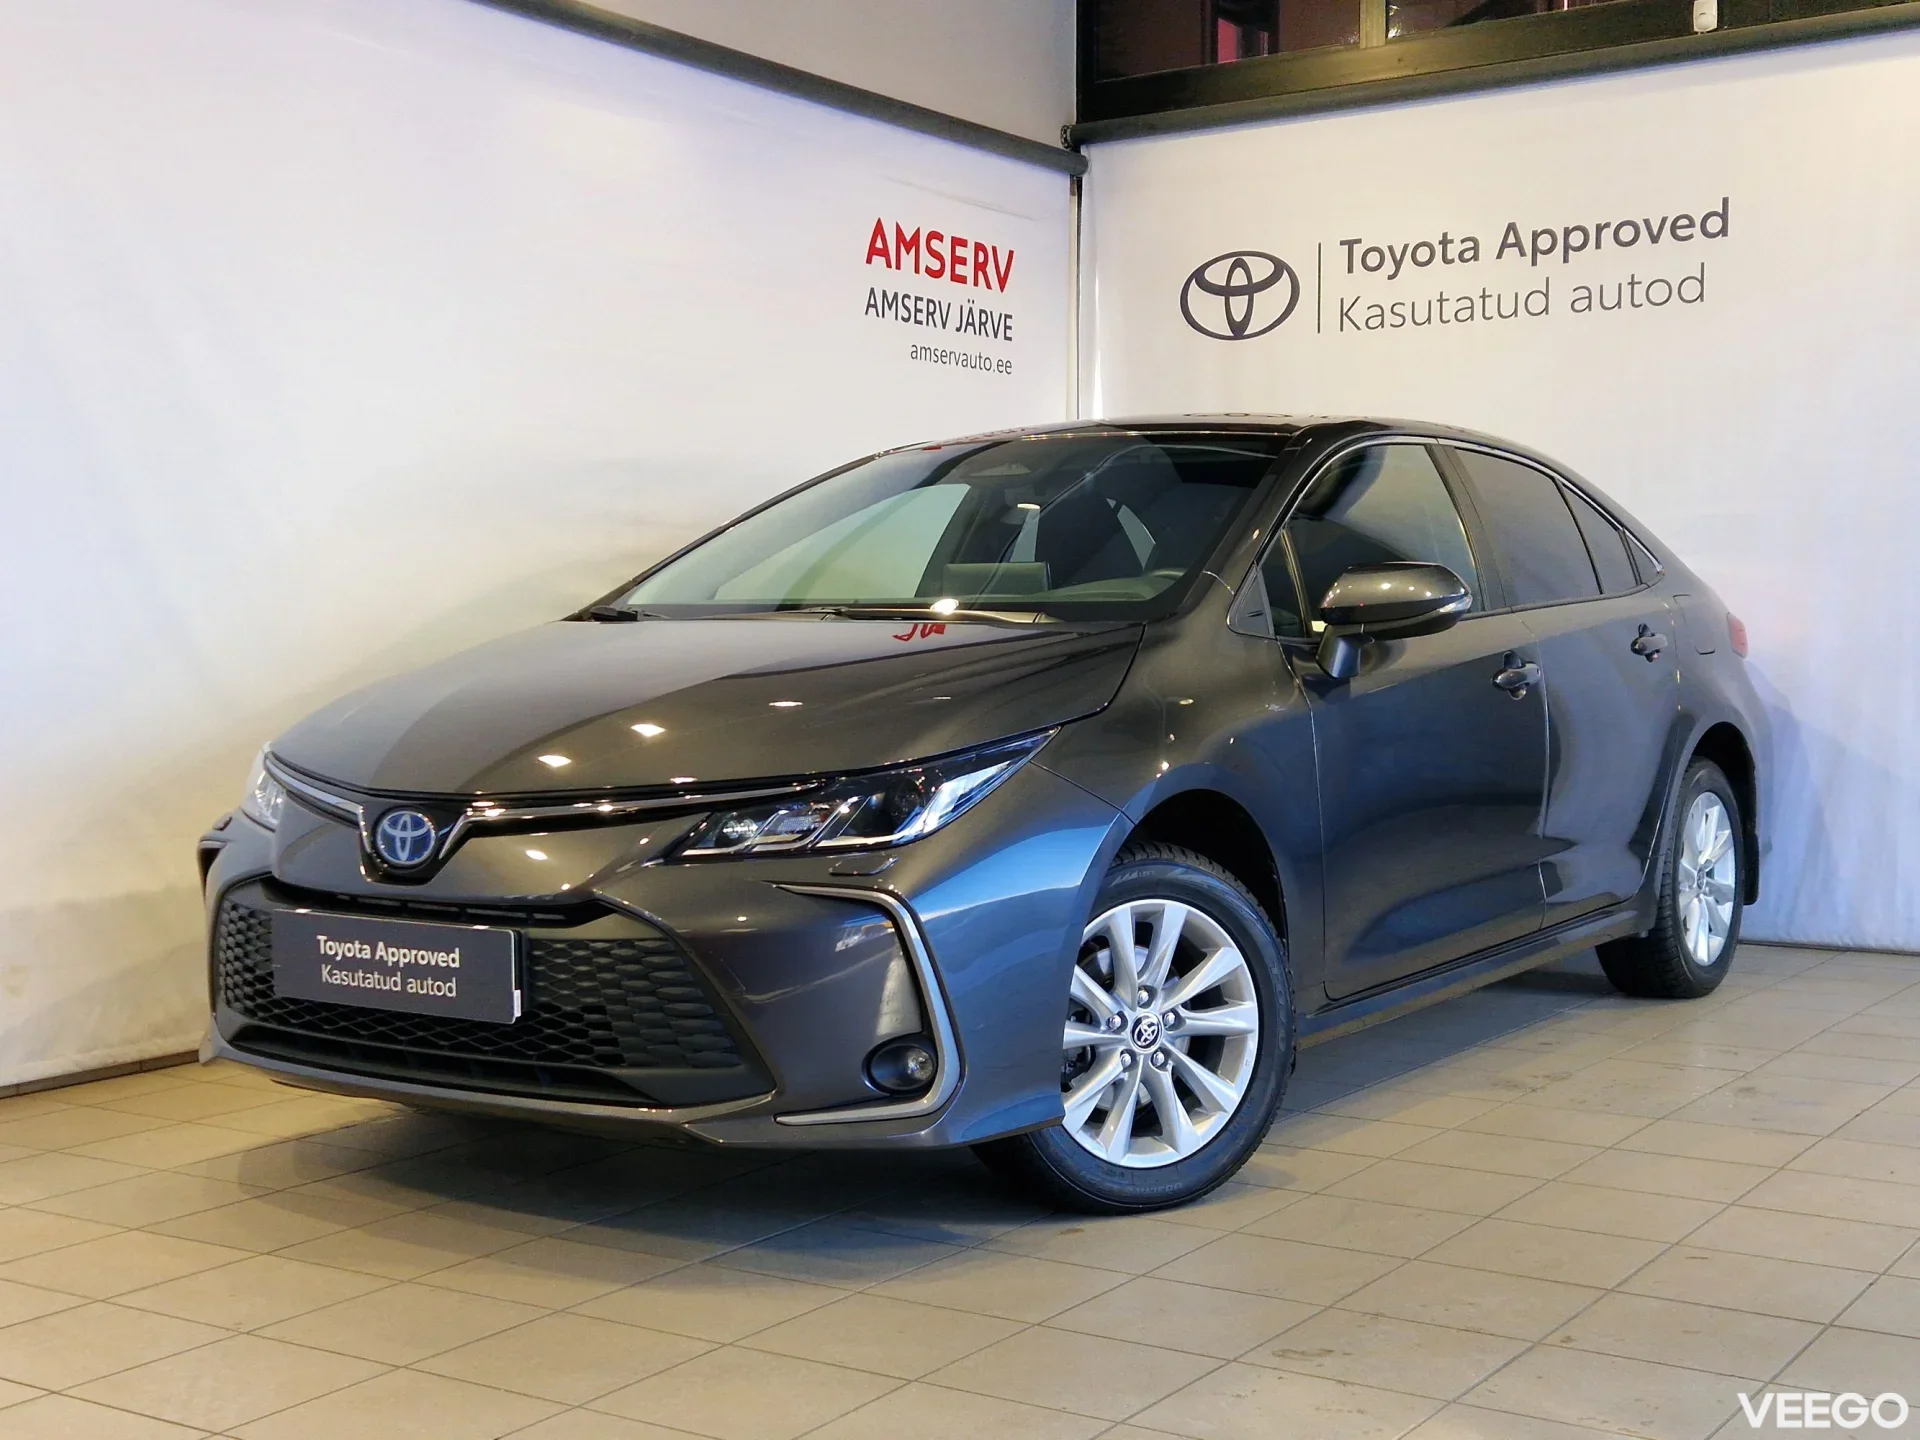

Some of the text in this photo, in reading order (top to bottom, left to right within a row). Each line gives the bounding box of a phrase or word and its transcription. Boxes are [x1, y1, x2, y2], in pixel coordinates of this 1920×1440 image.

[865, 217, 1015, 293] AMSERV
[1339, 196, 1730, 280] Toyota Approved
[864, 287, 1013, 341] AMSERV JÄRVE
[1339, 262, 1706, 332] Kasutatud autod
[910, 343, 1013, 375] amservauto.ee
[316, 935, 460, 968] Toyota Approved
[321, 963, 457, 998] Kasutatud autod
